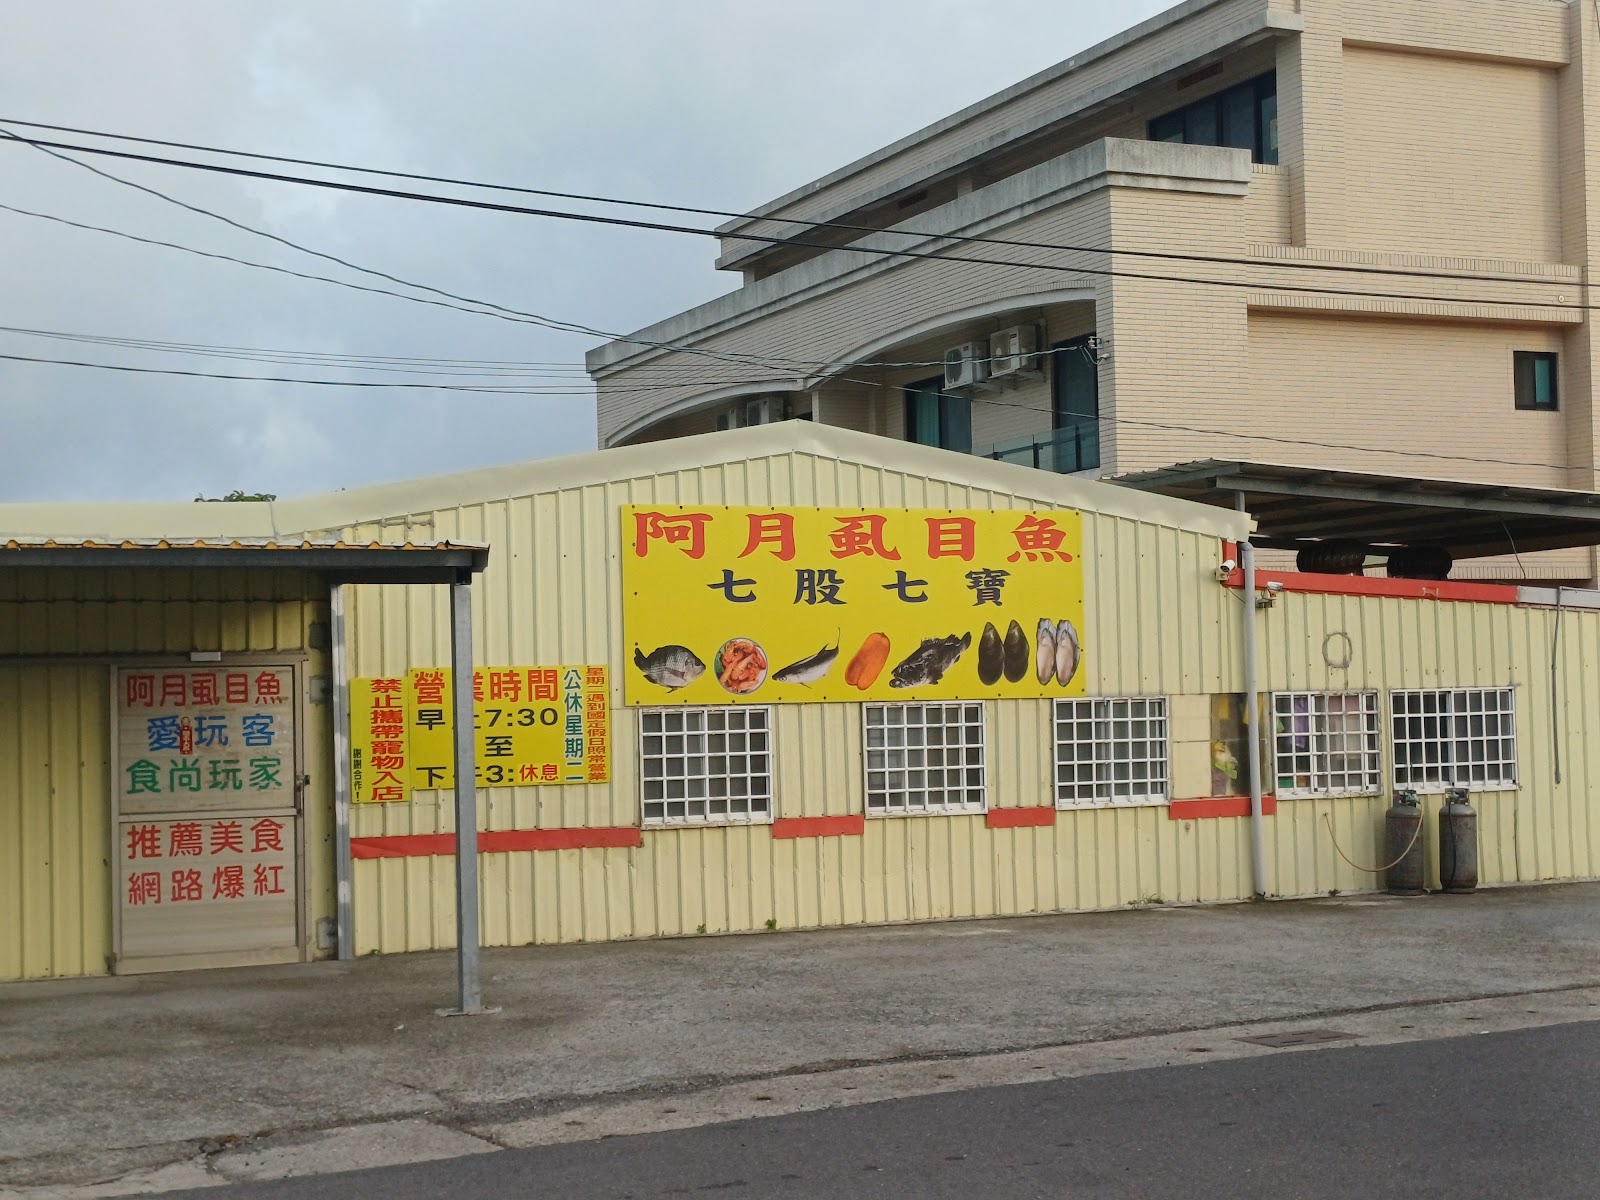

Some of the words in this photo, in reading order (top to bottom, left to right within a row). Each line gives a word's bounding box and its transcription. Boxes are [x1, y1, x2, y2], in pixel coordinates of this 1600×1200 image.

[635, 511, 1073, 563] 阿月虱目魚
[707, 568, 1011, 607] 七股七寶
[127, 671, 283, 707] 阿月虱目魚
[147, 713, 275, 752] 愛玩客
[416, 707, 559, 731] 早7:30
[563, 669, 584, 781] 公休星期二
[370, 679, 404, 801] 禁止攜帶寵物入店
[484, 735, 514, 757] 至
[126, 756, 283, 794] 食尚玩家
[127, 818, 284, 860] 推薦美食
[128, 863, 286, 906] 網路爆紅
